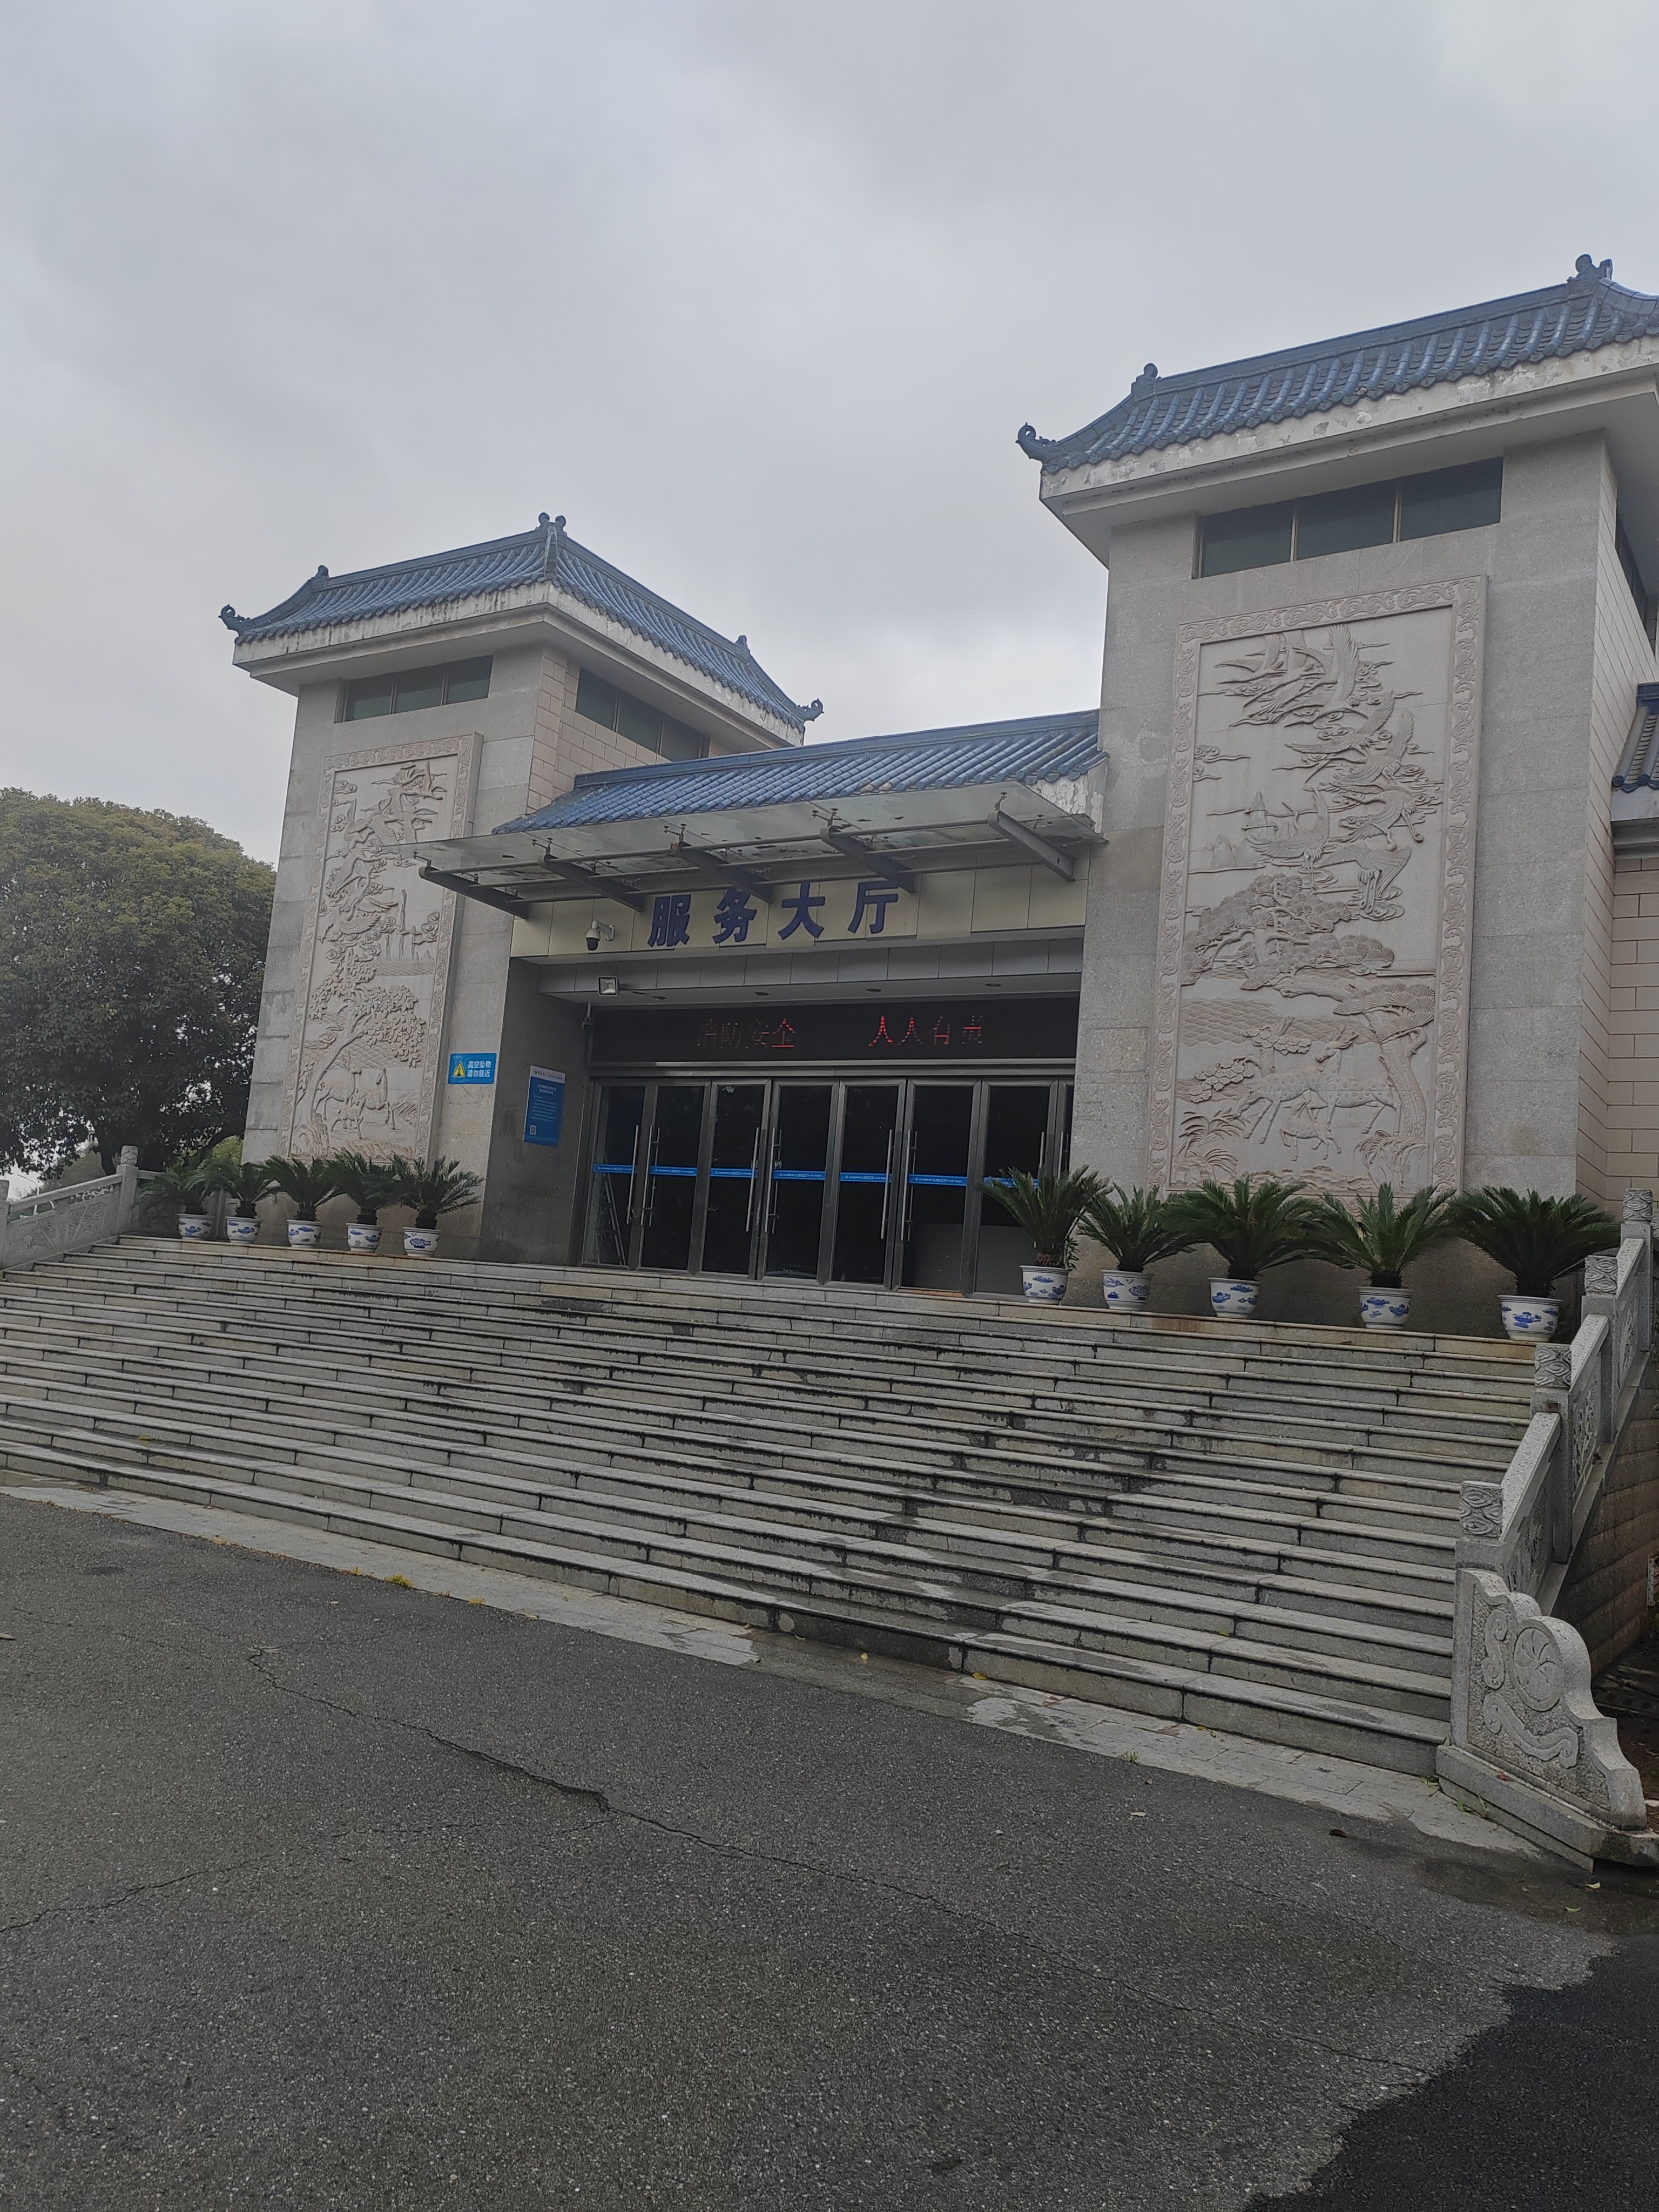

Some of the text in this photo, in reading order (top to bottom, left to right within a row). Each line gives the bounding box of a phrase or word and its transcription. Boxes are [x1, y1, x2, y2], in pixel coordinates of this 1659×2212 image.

[648, 881, 899, 947] 服务大厅
[467, 1061, 491, 1069] 高空坠物
[467, 1069, 491, 1077] 请勿靠近
